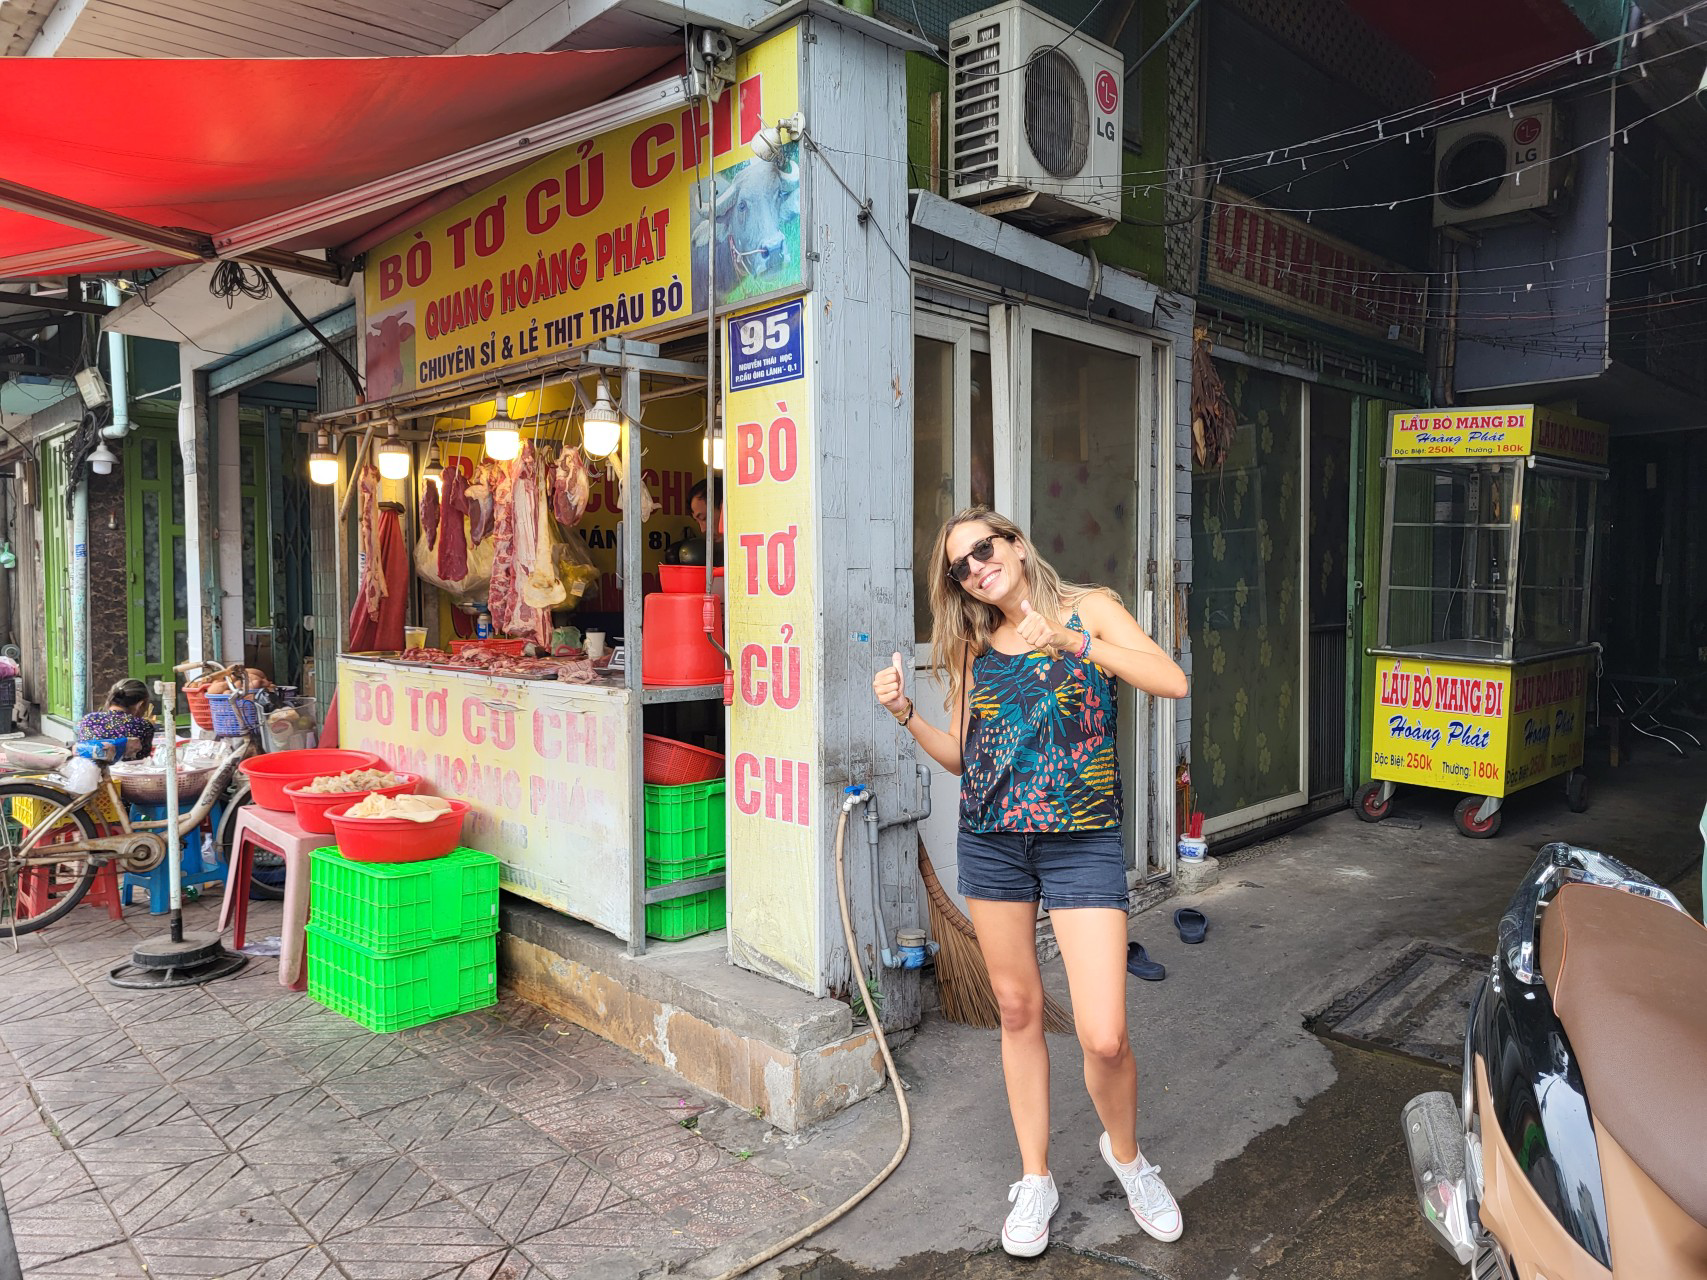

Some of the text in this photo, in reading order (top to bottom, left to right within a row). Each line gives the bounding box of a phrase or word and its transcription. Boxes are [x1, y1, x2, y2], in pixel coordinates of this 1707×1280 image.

[1096, 117, 1115, 142] LG
[1515, 148, 1537, 165] LG
[379, 73, 762, 301] BÒ TƠ CỦ CHI
[425, 206, 671, 341] QUANG HOÀNG PHÁT
[419, 274, 683, 384] CHUYÊN SỈ & LẺ THỊT TRÂU BÒ
[740, 311, 790, 356] 95
[763, 356, 777, 367] THÁI
[779, 353, 793, 363] HỌC
[737, 401, 798, 486] BÒ
[1400, 415, 1525, 431] LẨU BÒ MANG ĐI
[1416, 431, 1505, 445] Hoàng Phát
[1428, 446, 1454, 454] 250k
[1496, 444, 1524, 453] 180k
[740, 525, 797, 597] TƠ
[740, 624, 801, 711] CỦ
[1382, 660, 1503, 716] LẨU BÒ MANG ĐI
[354, 673, 617, 771] BÒ TƠ CỦ CHI
[1389, 715, 1490, 749] Hoàng Phát
[435, 754, 522, 811] HOÀNG
[530, 775, 604, 825] PHÁ
[735, 752, 810, 827] CHI
[1407, 752, 1432, 771] 250k
[1442, 761, 1471, 779] Thường:
[1473, 761, 1499, 780] 180k
